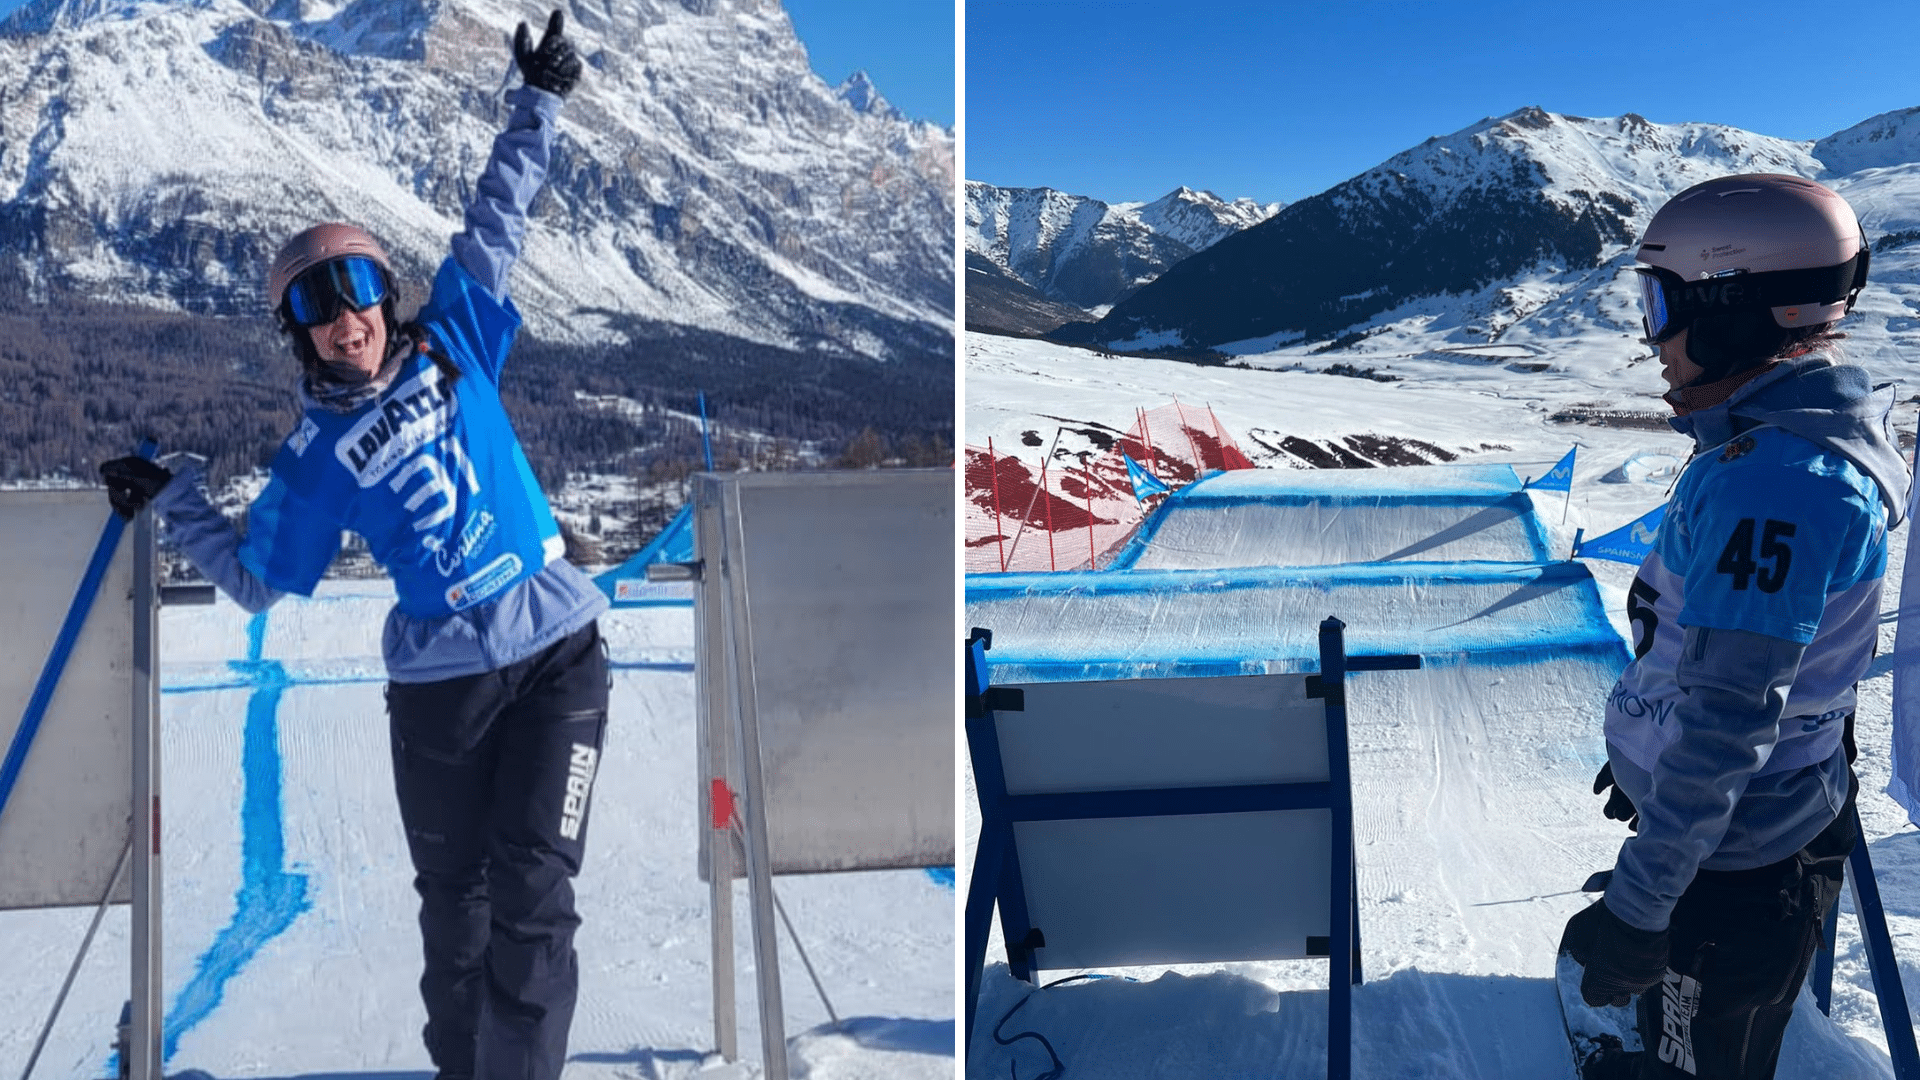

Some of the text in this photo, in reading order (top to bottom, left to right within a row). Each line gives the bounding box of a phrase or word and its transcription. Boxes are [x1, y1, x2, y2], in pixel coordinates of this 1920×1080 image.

[1716, 518, 1797, 594] 45
[560, 743, 590, 838] SPAIN
[1658, 966, 1685, 1070] SPAIN
[1680, 995, 1692, 1019] TEAM
